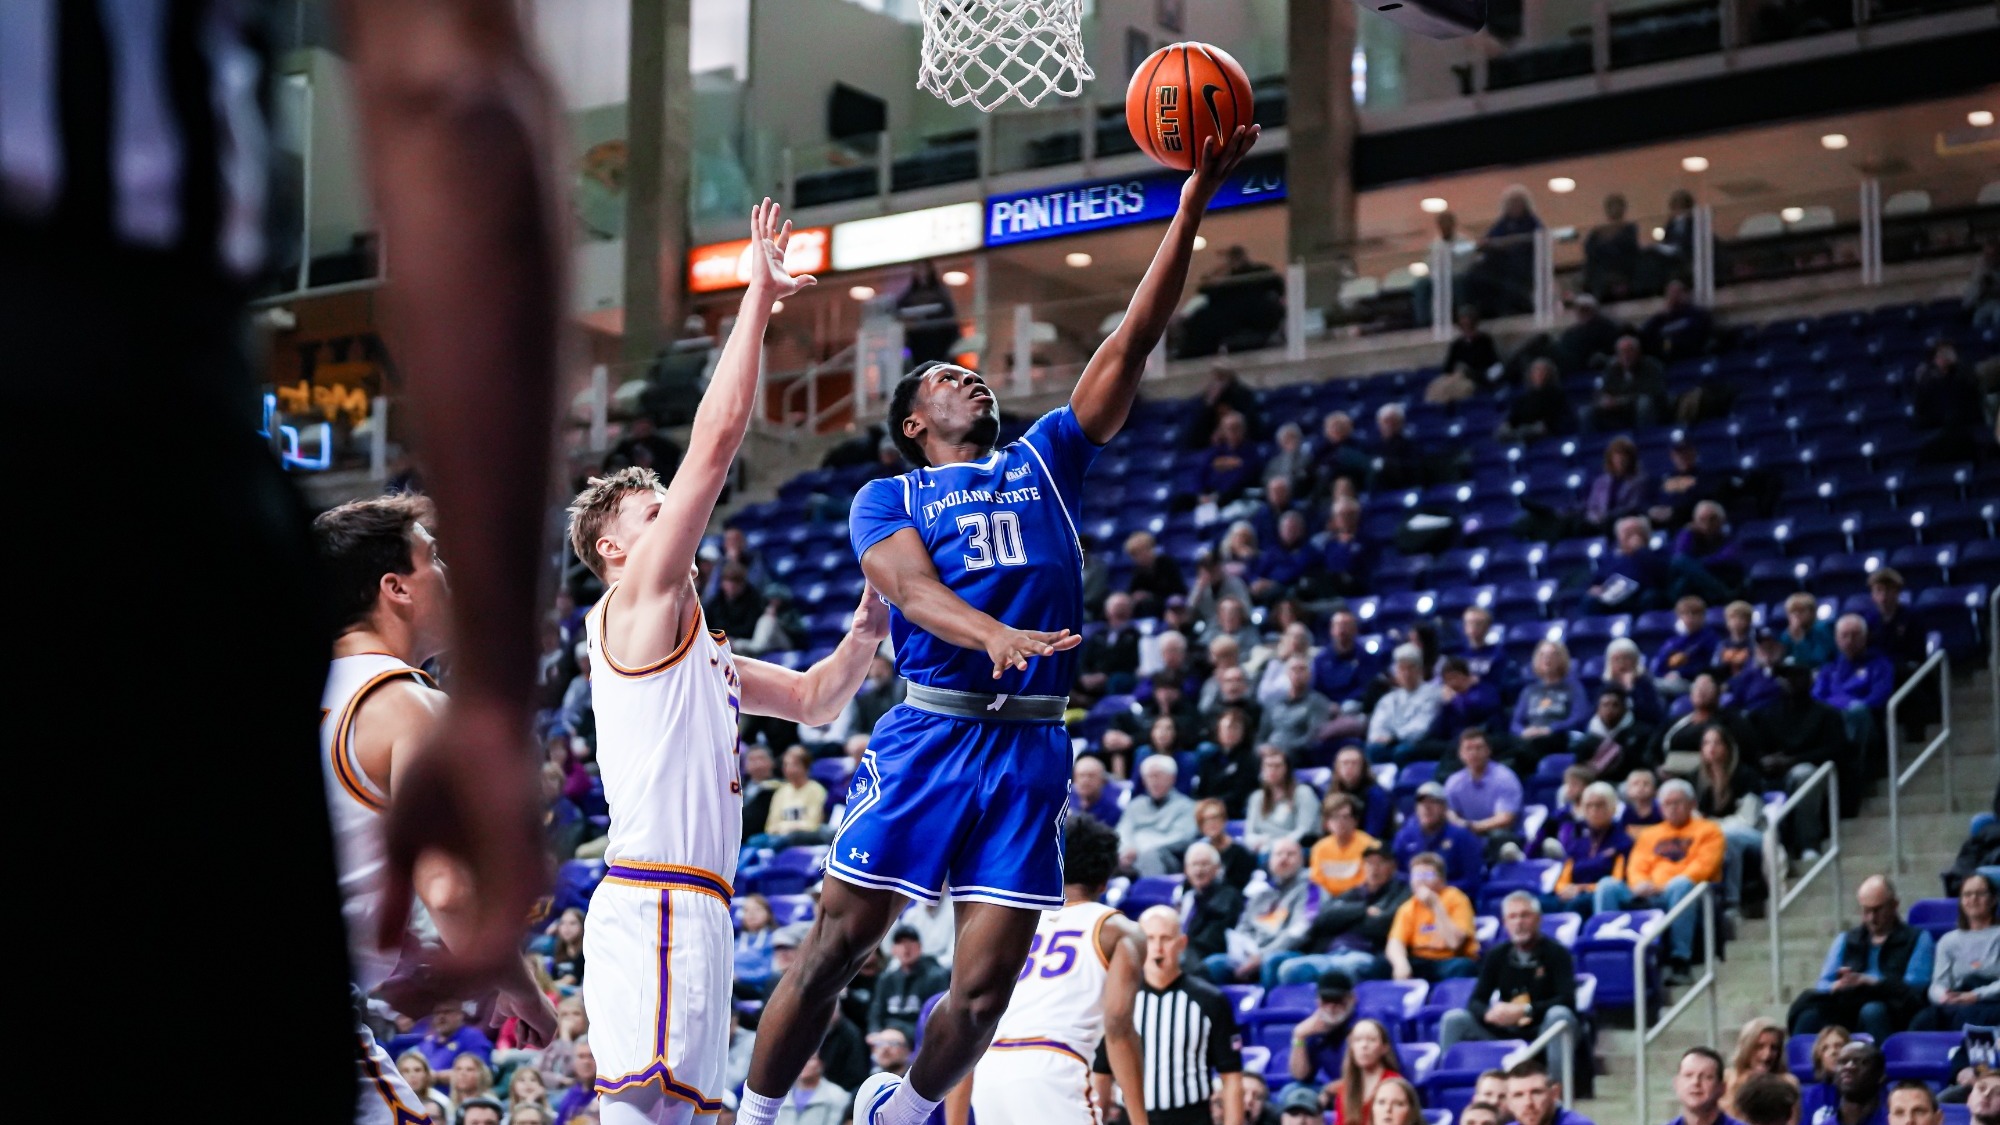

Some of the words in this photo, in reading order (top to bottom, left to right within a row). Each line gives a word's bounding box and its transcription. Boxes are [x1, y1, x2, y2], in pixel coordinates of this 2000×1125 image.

[1160, 86, 1183, 152] ELITE
[991, 182, 1144, 236] PANTHERS
[923, 490, 993, 526] INDIANA
[995, 487, 1041, 504] STATE
[956, 511, 1027, 571] 30
